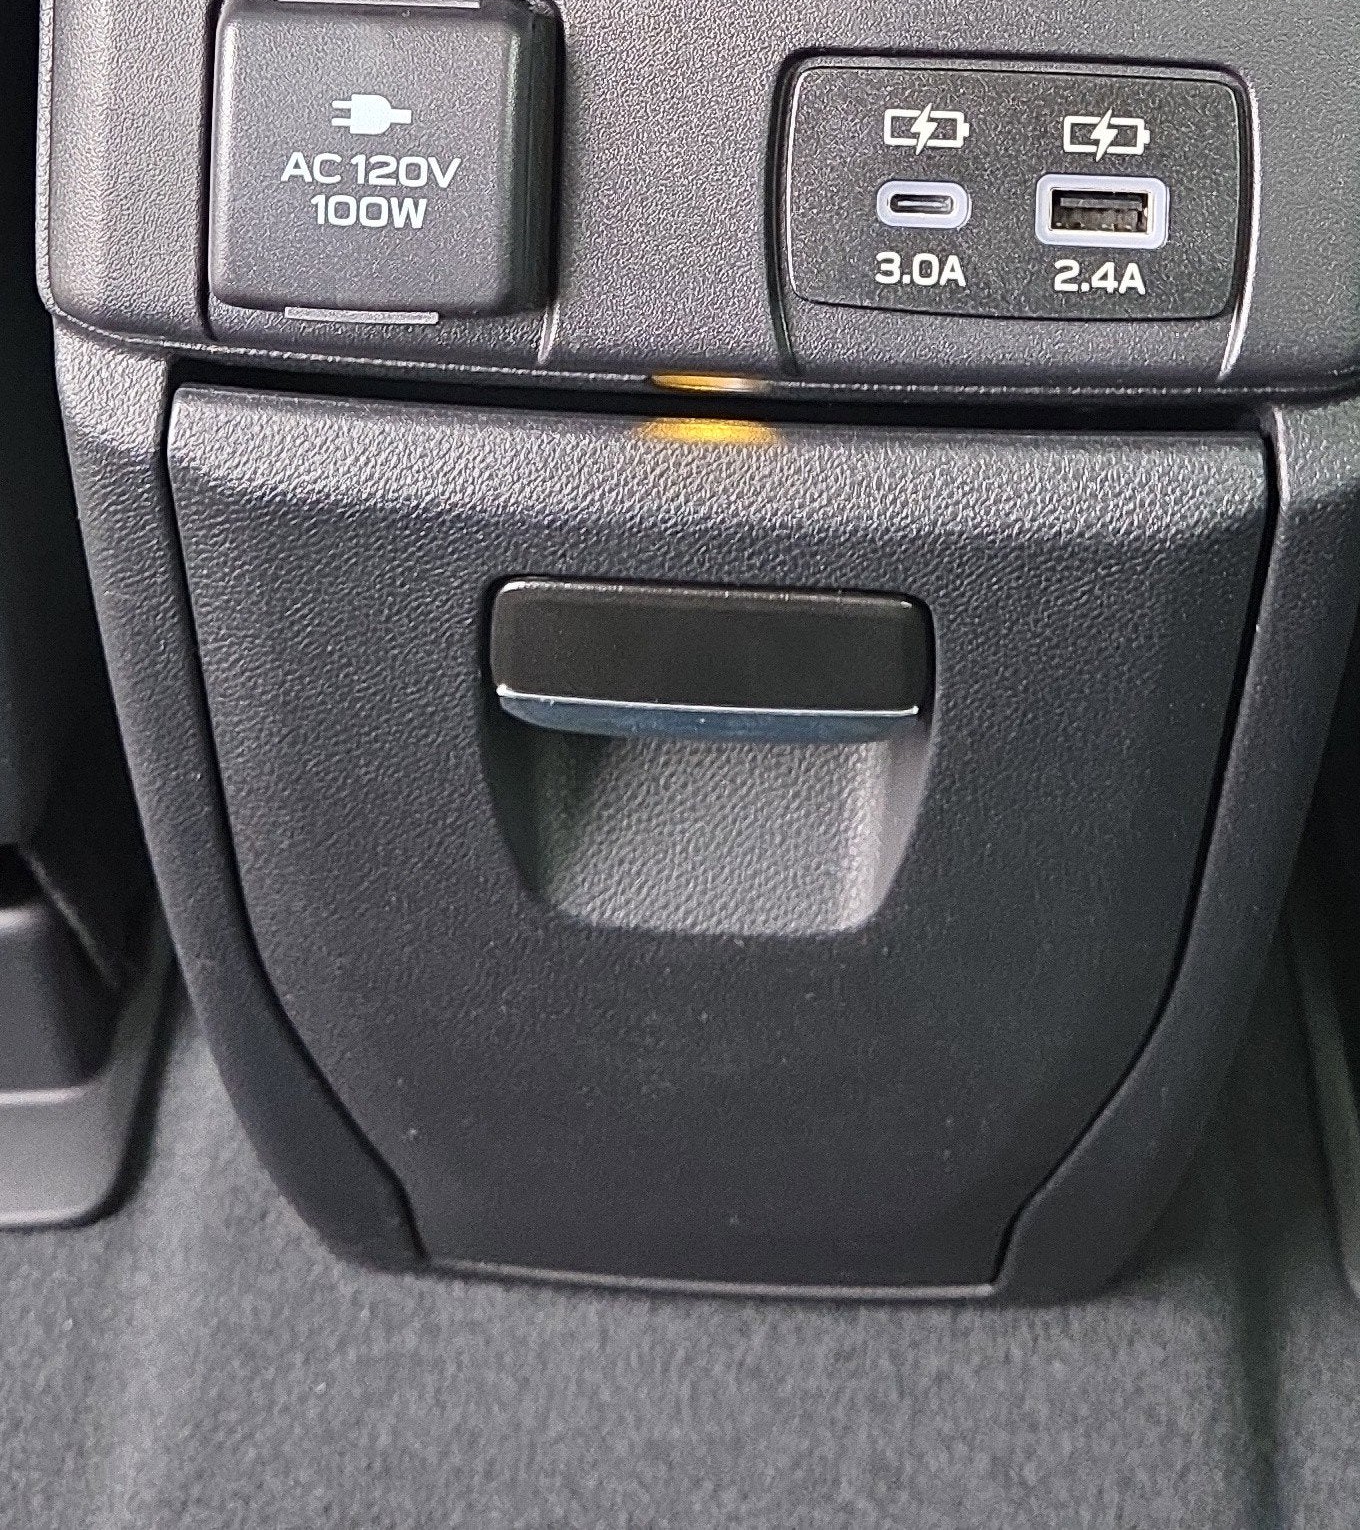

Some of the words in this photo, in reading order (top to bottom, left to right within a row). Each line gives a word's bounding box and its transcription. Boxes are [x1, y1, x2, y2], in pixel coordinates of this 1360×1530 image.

[280, 151, 343, 184] AC
[350, 154, 462, 189] 120V
[310, 194, 428, 229] 100W
[874, 251, 967, 288] 3.0A
[1053, 259, 1147, 296] 2.4A
